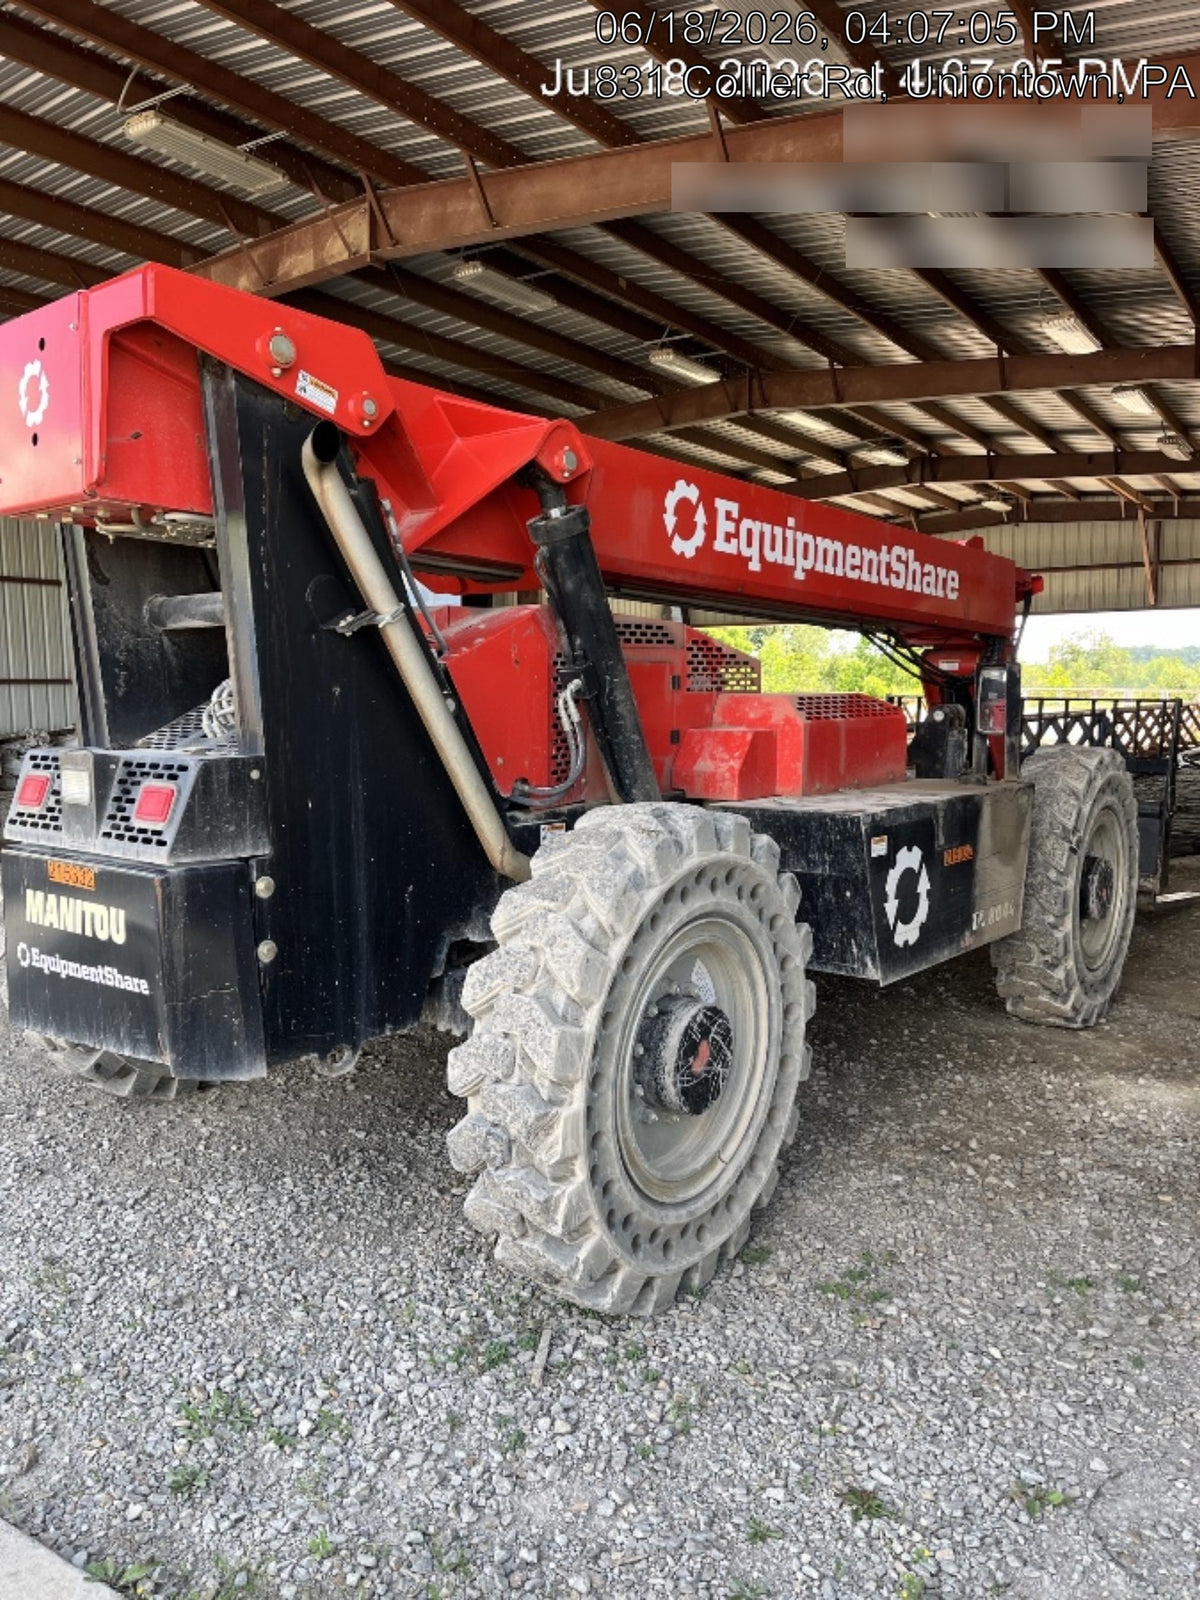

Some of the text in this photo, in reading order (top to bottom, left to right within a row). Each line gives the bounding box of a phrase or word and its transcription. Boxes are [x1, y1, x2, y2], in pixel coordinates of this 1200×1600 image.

[713, 498, 959, 600] EquipmentShare
[25, 888, 126, 945] MANITOU
[30, 947, 150, 995] EquipmentShare
